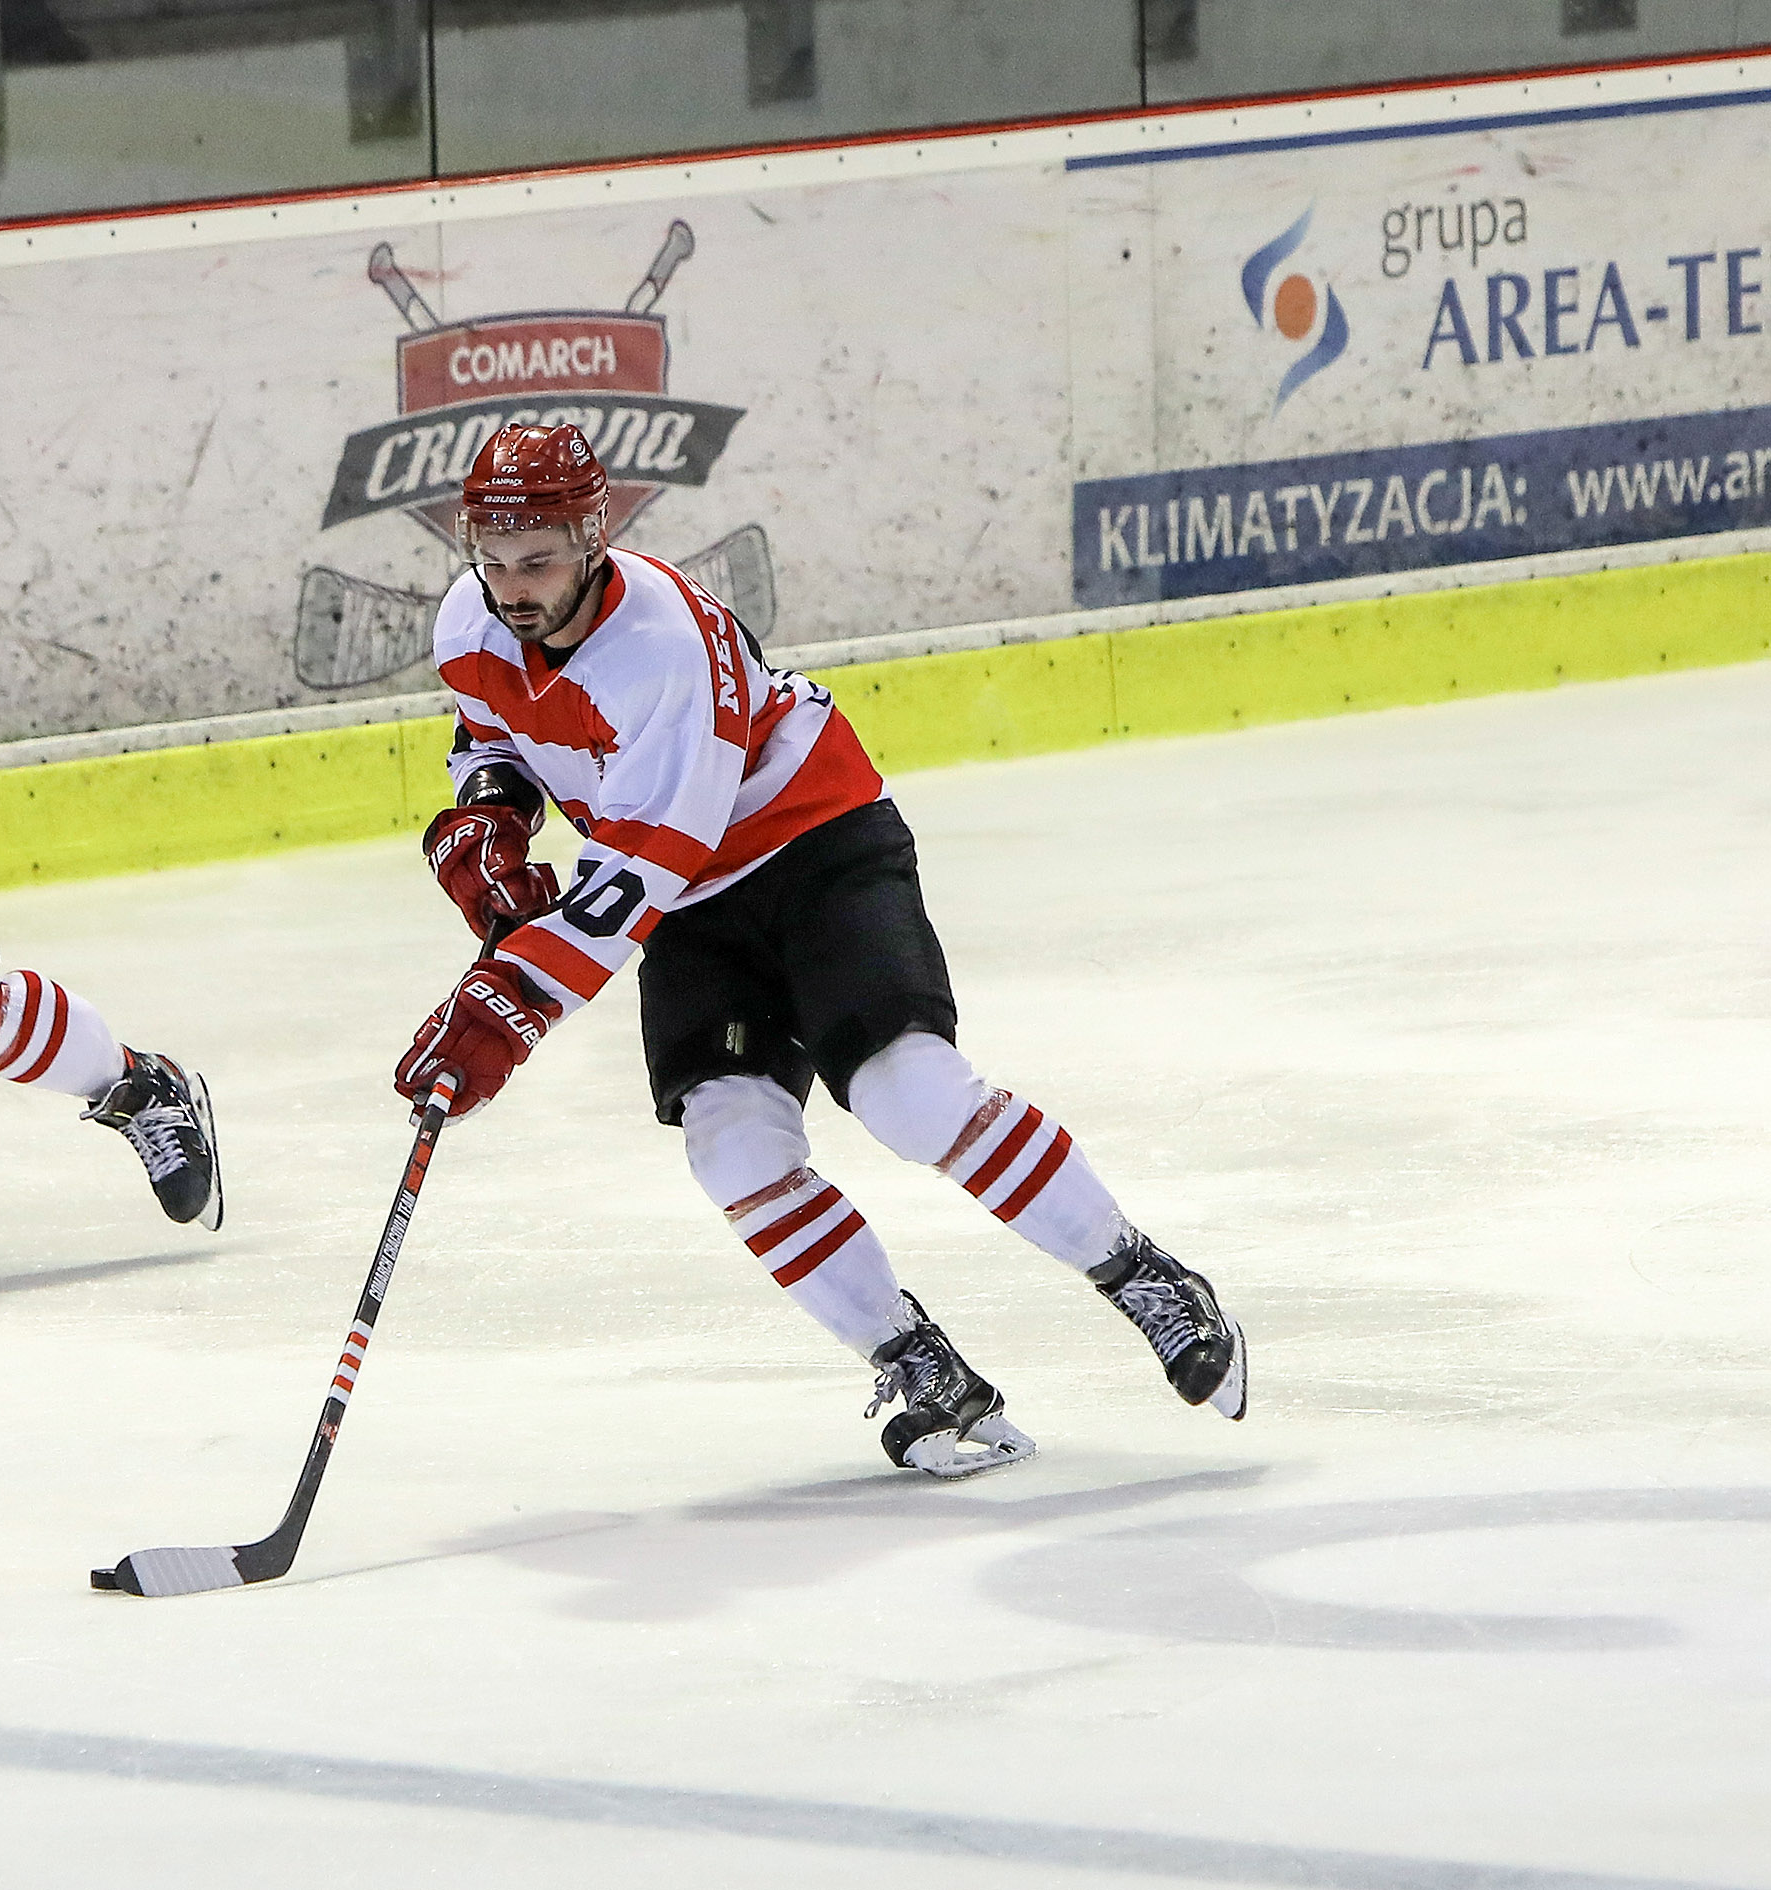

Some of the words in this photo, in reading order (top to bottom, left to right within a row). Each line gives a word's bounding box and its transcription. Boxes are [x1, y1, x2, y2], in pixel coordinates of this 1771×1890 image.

[1381, 197, 1528, 279] grupa
[1422, 247, 1764, 371] AREA-TE
[450, 335, 617, 385] COMARCH
[483, 495, 527, 504] BAUER
[1098, 463, 1527, 571] KLIMATYZACJA:
[397, 1188, 417, 1219] TEAM
